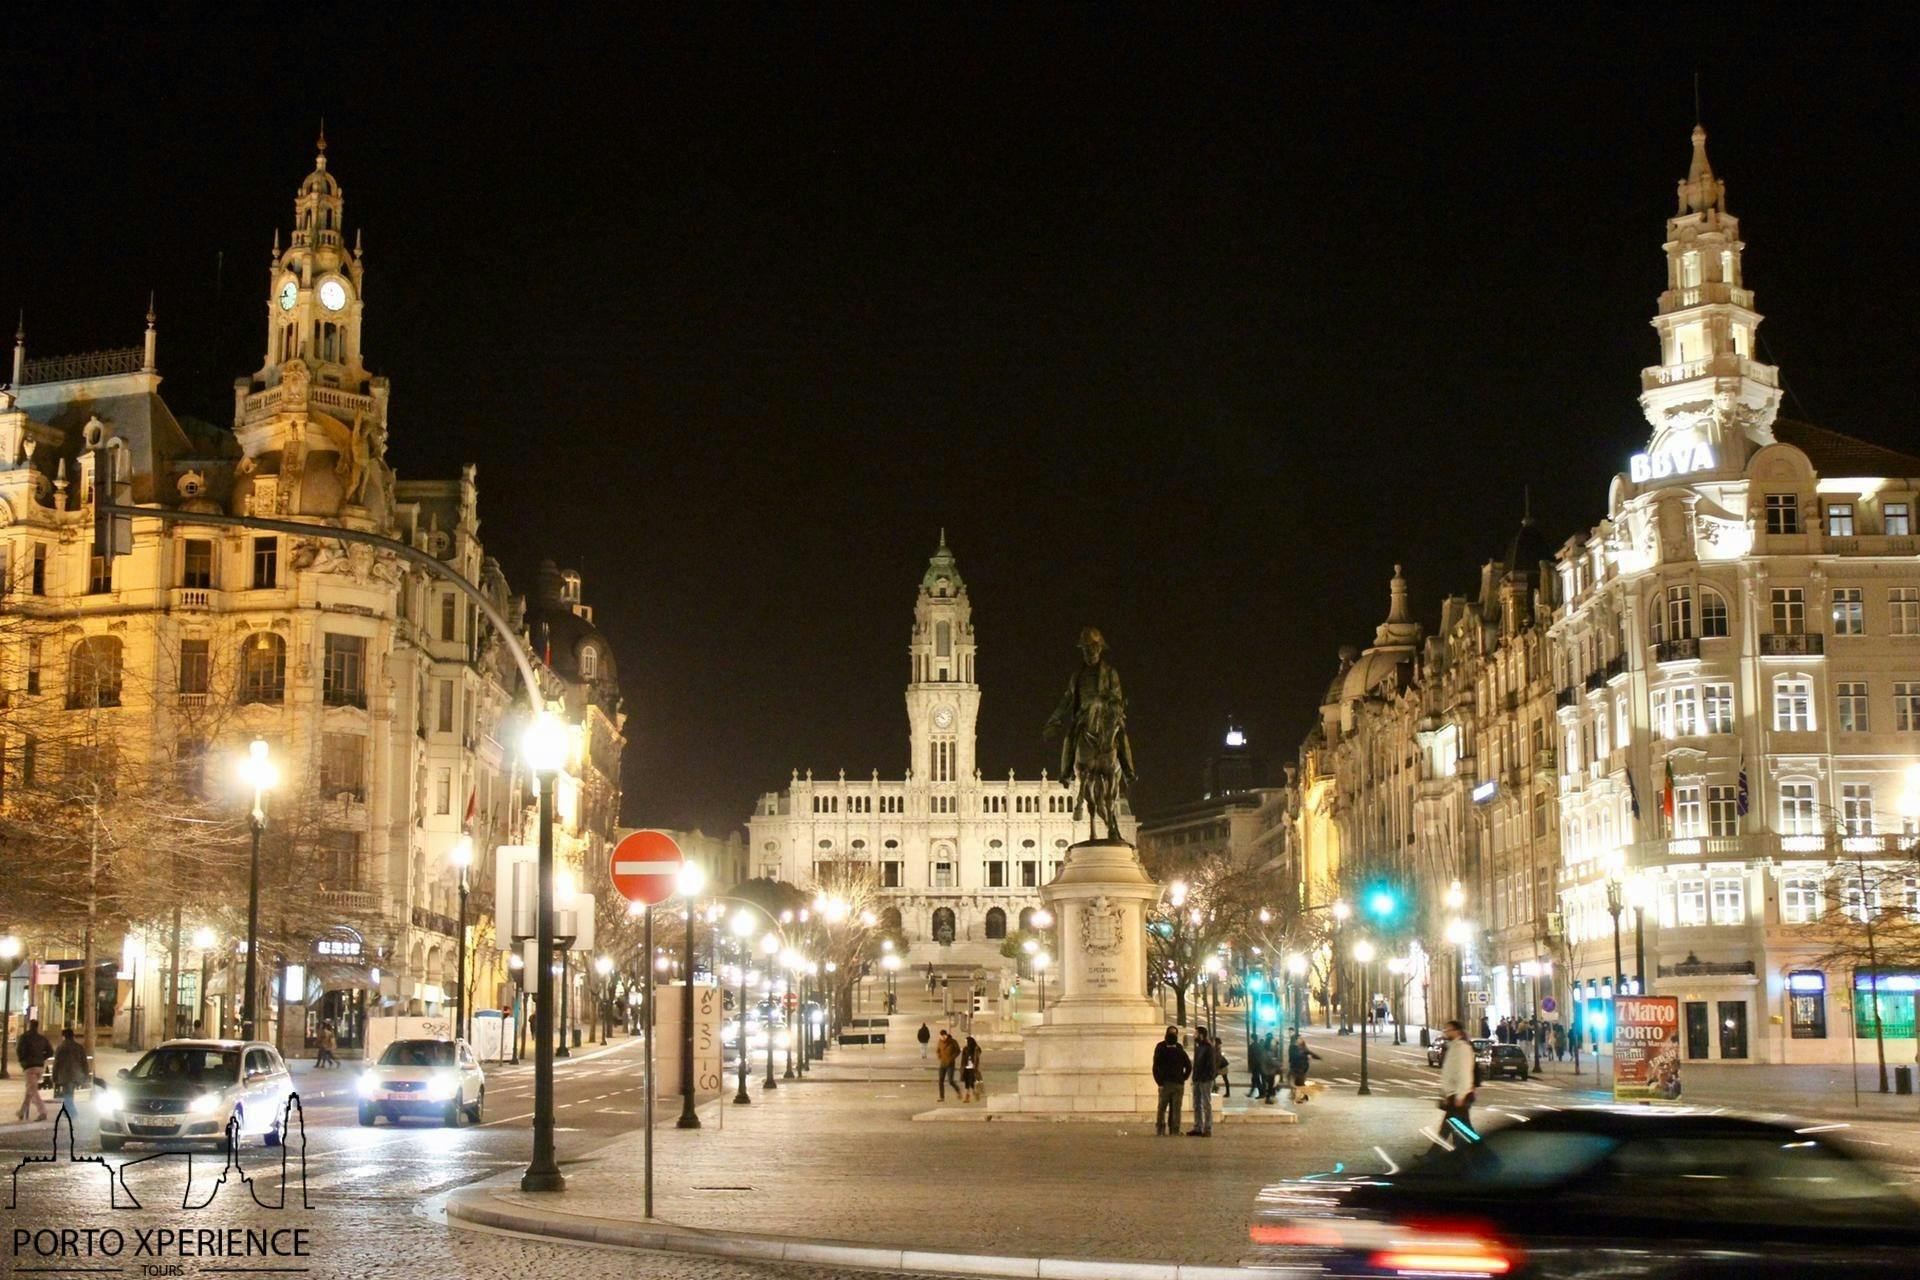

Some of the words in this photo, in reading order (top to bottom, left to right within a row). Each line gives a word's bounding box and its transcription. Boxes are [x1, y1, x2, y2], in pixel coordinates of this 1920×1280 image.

[1630, 441, 1715, 483] BBVA
[1615, 1001, 1626, 1022] 7
[1628, 1001, 1675, 1024] Março
[1615, 1026, 1664, 1040] PORTO
